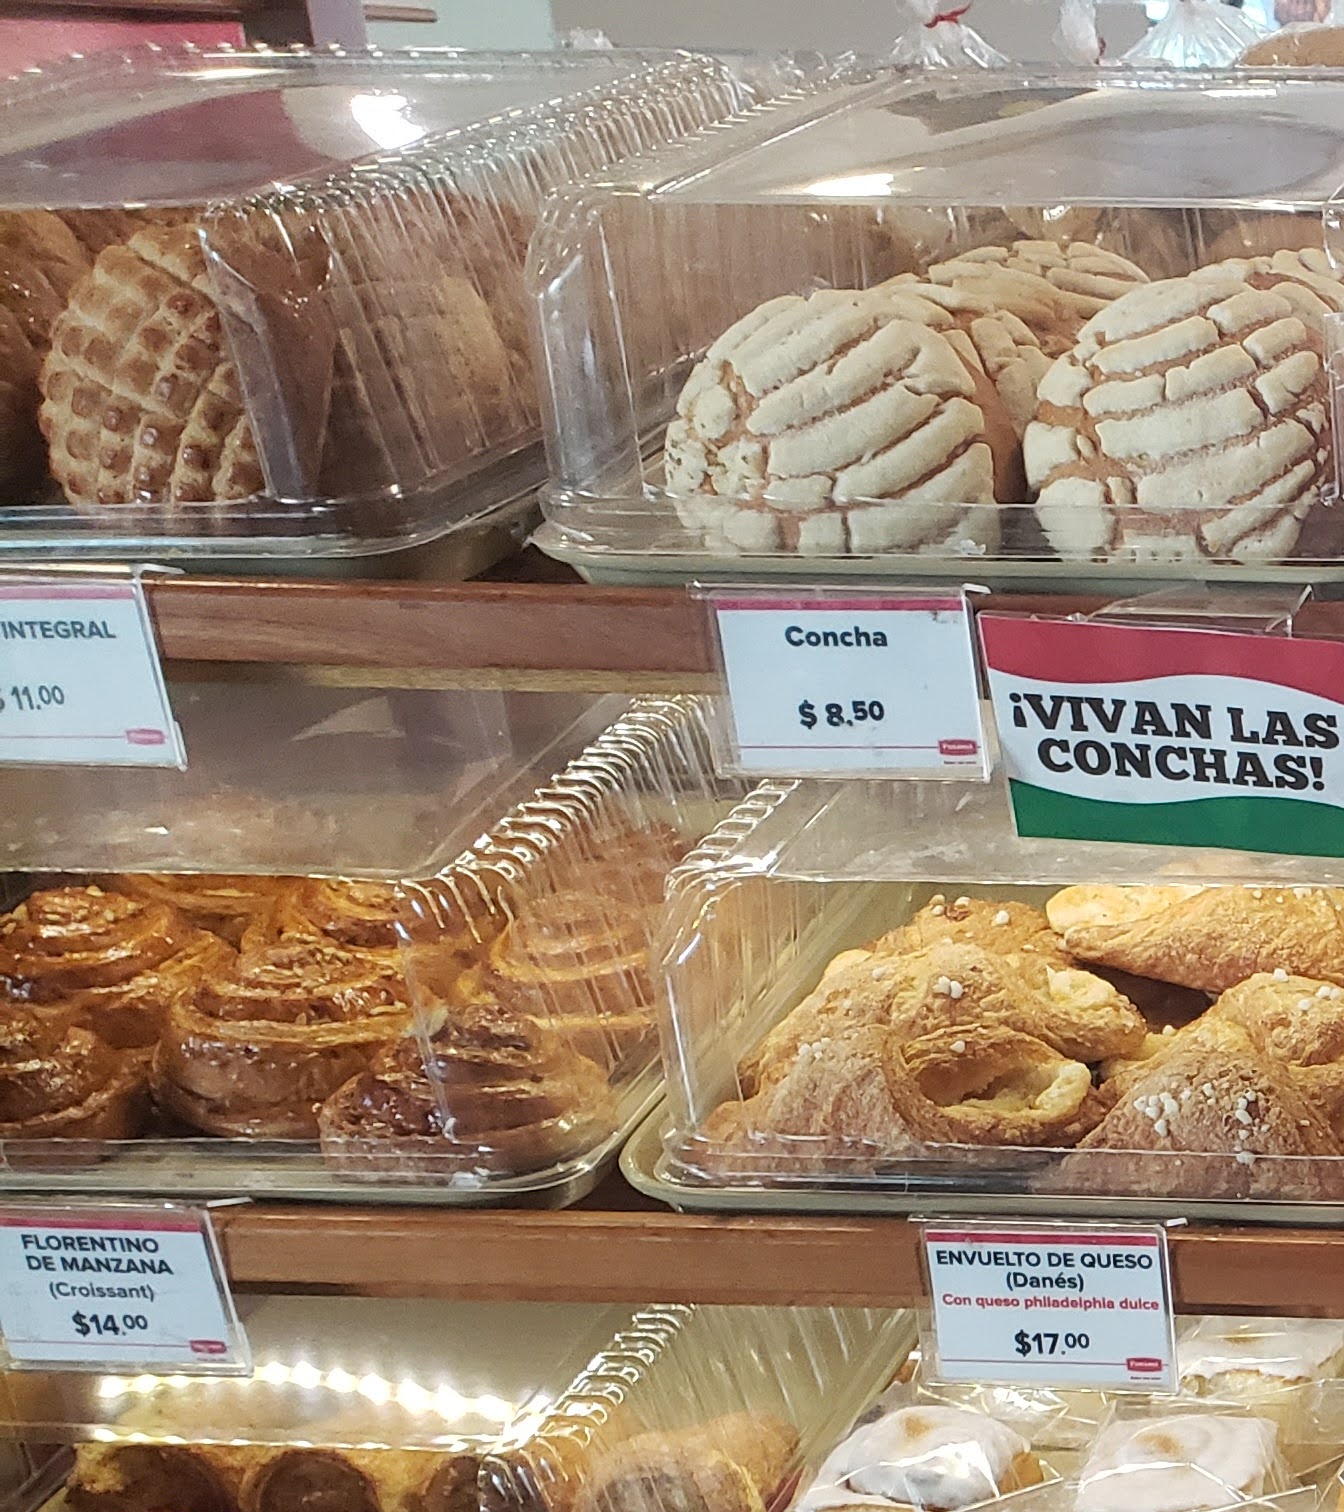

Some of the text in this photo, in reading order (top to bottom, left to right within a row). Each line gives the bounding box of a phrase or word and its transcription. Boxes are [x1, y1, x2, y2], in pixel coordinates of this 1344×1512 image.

[785, 625, 888, 647] Concha
[11, 685, 65, 710] 11.00
[798, 700, 885, 729] $ 8.50
[1009, 692, 1340, 750] ¡VIVAN LAS
[1037, 737, 1325, 791] CONCHAS!
[20, 1233, 159, 1254] FLORENTINO
[26, 1255, 174, 1275] DE MANZANA
[936, 1250, 1153, 1270] ENVUELTO DE QUESO
[49, 1281, 155, 1302] (Croissant)
[1006, 1271, 1085, 1293] (Danés)
[942, 1293, 1160, 1312] Con queso philadelphia dulce
[71, 1310, 148, 1337] $14.00
[1014, 1329, 1090, 1357] $17.00
